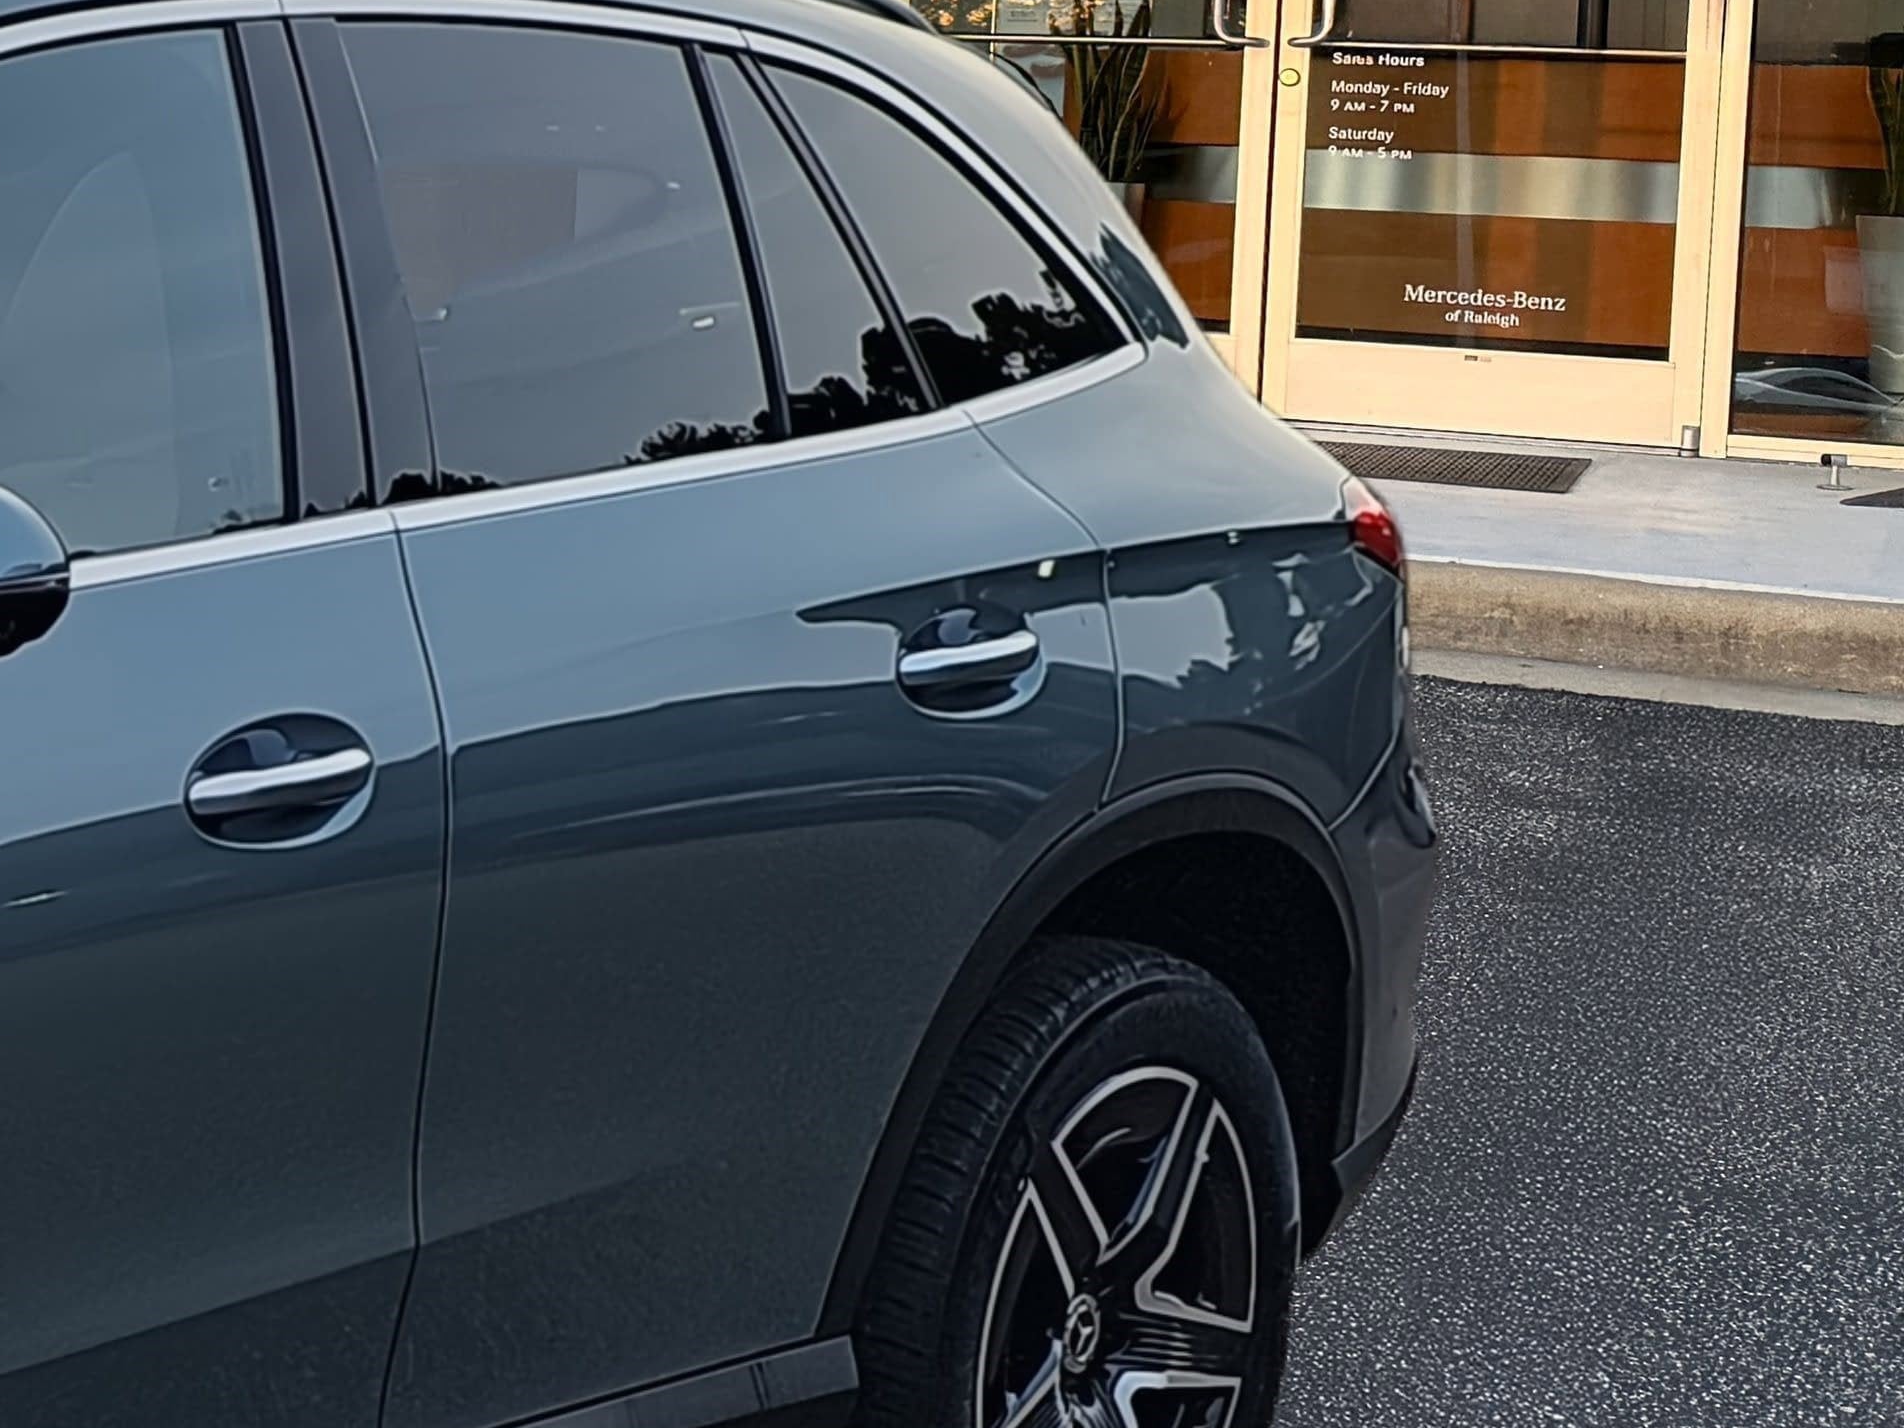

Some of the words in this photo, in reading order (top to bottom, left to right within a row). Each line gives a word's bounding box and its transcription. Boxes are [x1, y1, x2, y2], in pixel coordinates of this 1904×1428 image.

[1378, 53, 1425, 67] Hours
[1331, 80, 1390, 97] Monday
[1403, 82, 1449, 99] Friday
[1330, 98, 1340, 111] 9
[1344, 102, 1366, 111] AM
[1380, 100, 1389, 112] 7
[1393, 103, 1415, 113] PM
[1328, 126, 1394, 144] Saturday
[1328, 145, 1337, 157] 9
[1342, 148, 1363, 158] AM
[1377, 147, 1386, 158] 5
[1391, 149, 1412, 159] PM
[1403, 284, 1566, 311] Mercedes-Benz
[1445, 310, 1460, 322] of
